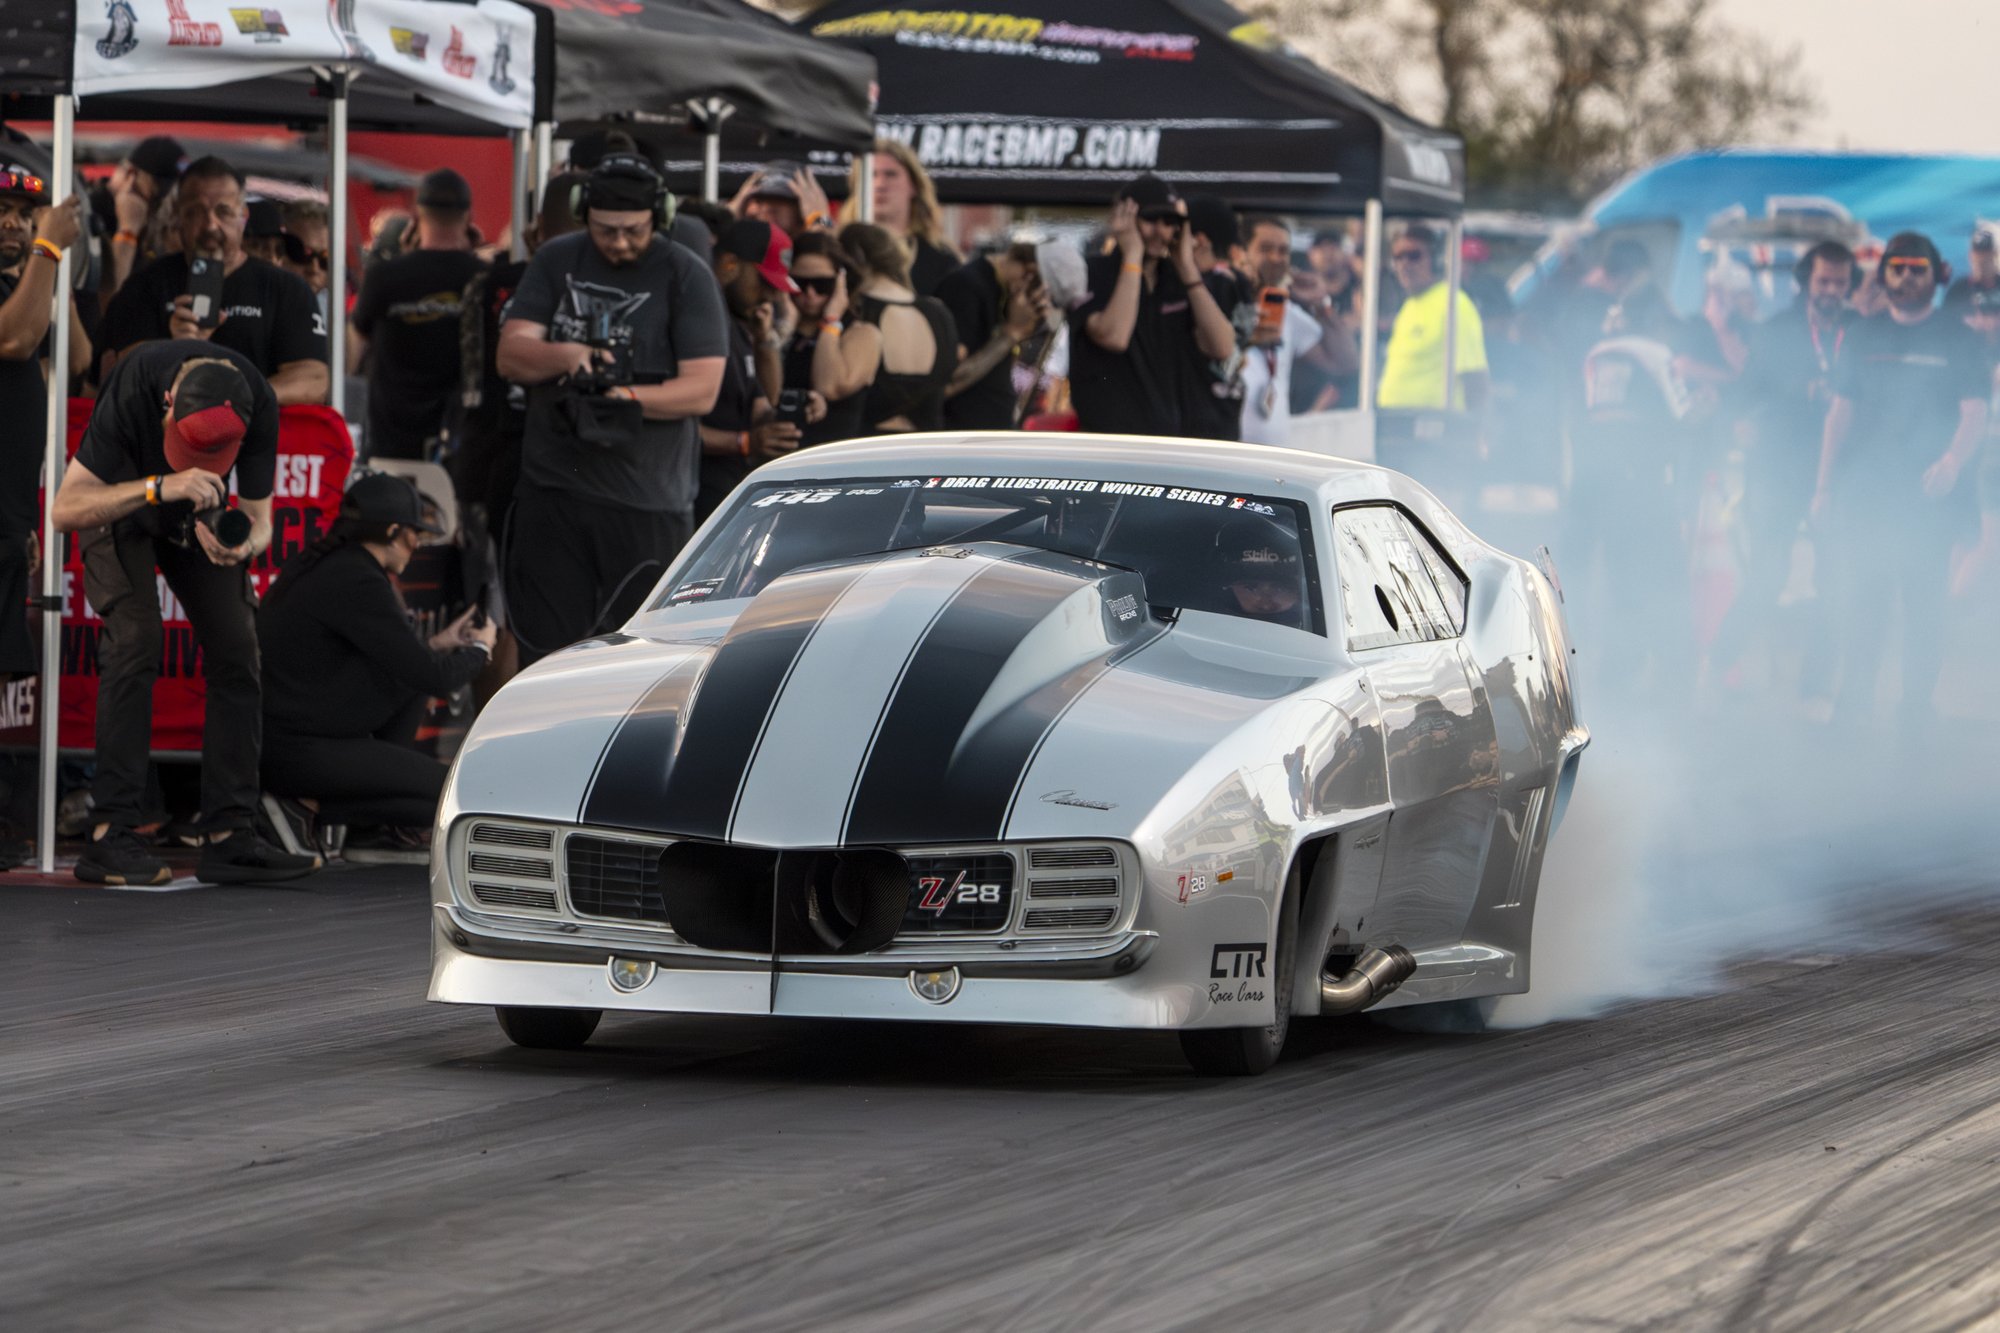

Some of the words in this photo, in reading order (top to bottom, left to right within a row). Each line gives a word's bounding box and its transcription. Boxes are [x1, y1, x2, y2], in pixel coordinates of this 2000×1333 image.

[751, 491, 842, 508] 445
[941, 477, 987, 489] DRAG
[991, 477, 1099, 492] ILLUSTRATED
[1100, 482, 1162, 498] WINTER
[1166, 488, 1227, 506] SERIES
[919, 870, 1000, 917] Z/28
[1177, 865, 1207, 907] Z/28
[1210, 943, 1268, 979] CTR
[1208, 982, 1234, 1005] Race
[1237, 981, 1265, 1002] Cars
